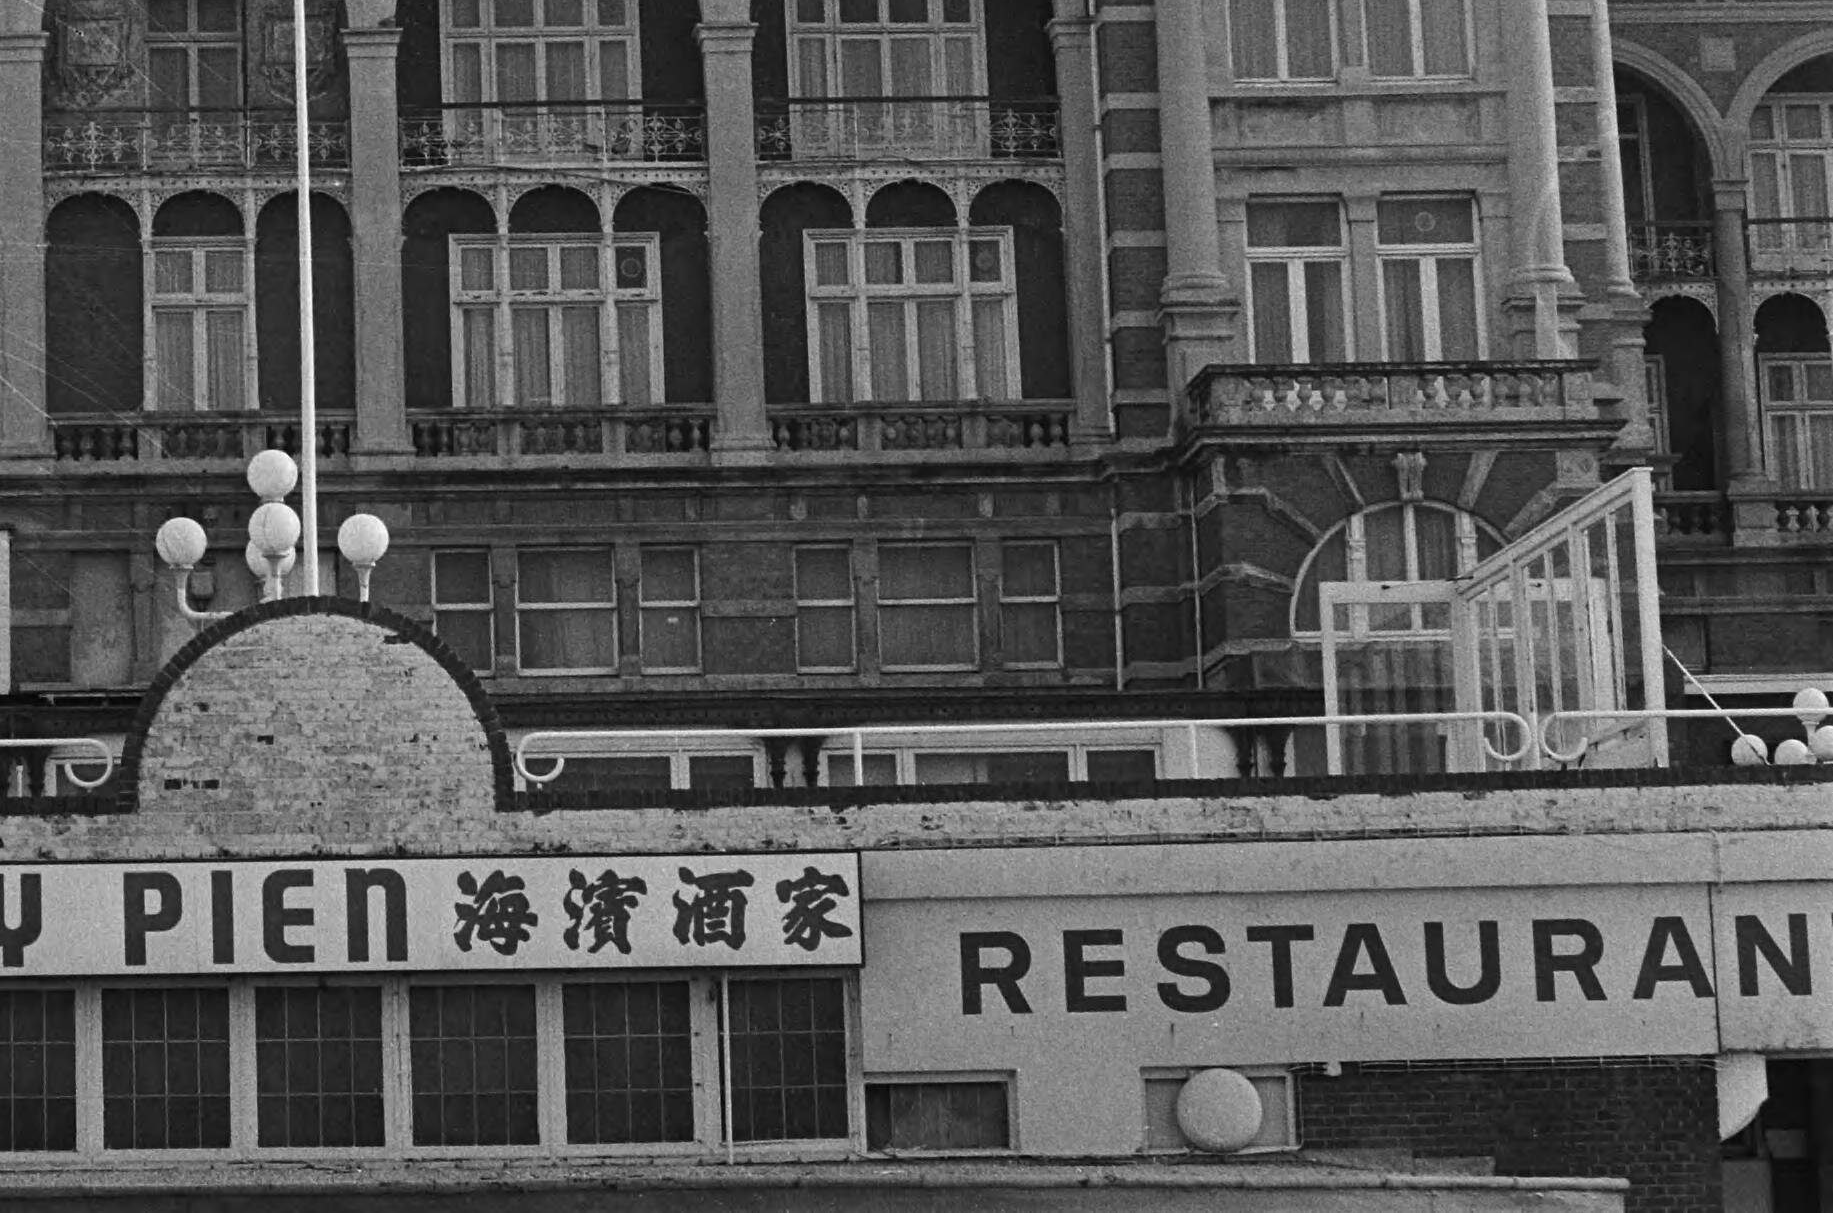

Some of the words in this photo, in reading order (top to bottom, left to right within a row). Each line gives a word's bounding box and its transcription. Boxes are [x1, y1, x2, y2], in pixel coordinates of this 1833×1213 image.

[454, 866, 854, 956] 海濱酒家
[959, 912, 1833, 1016] RESTAURAN
